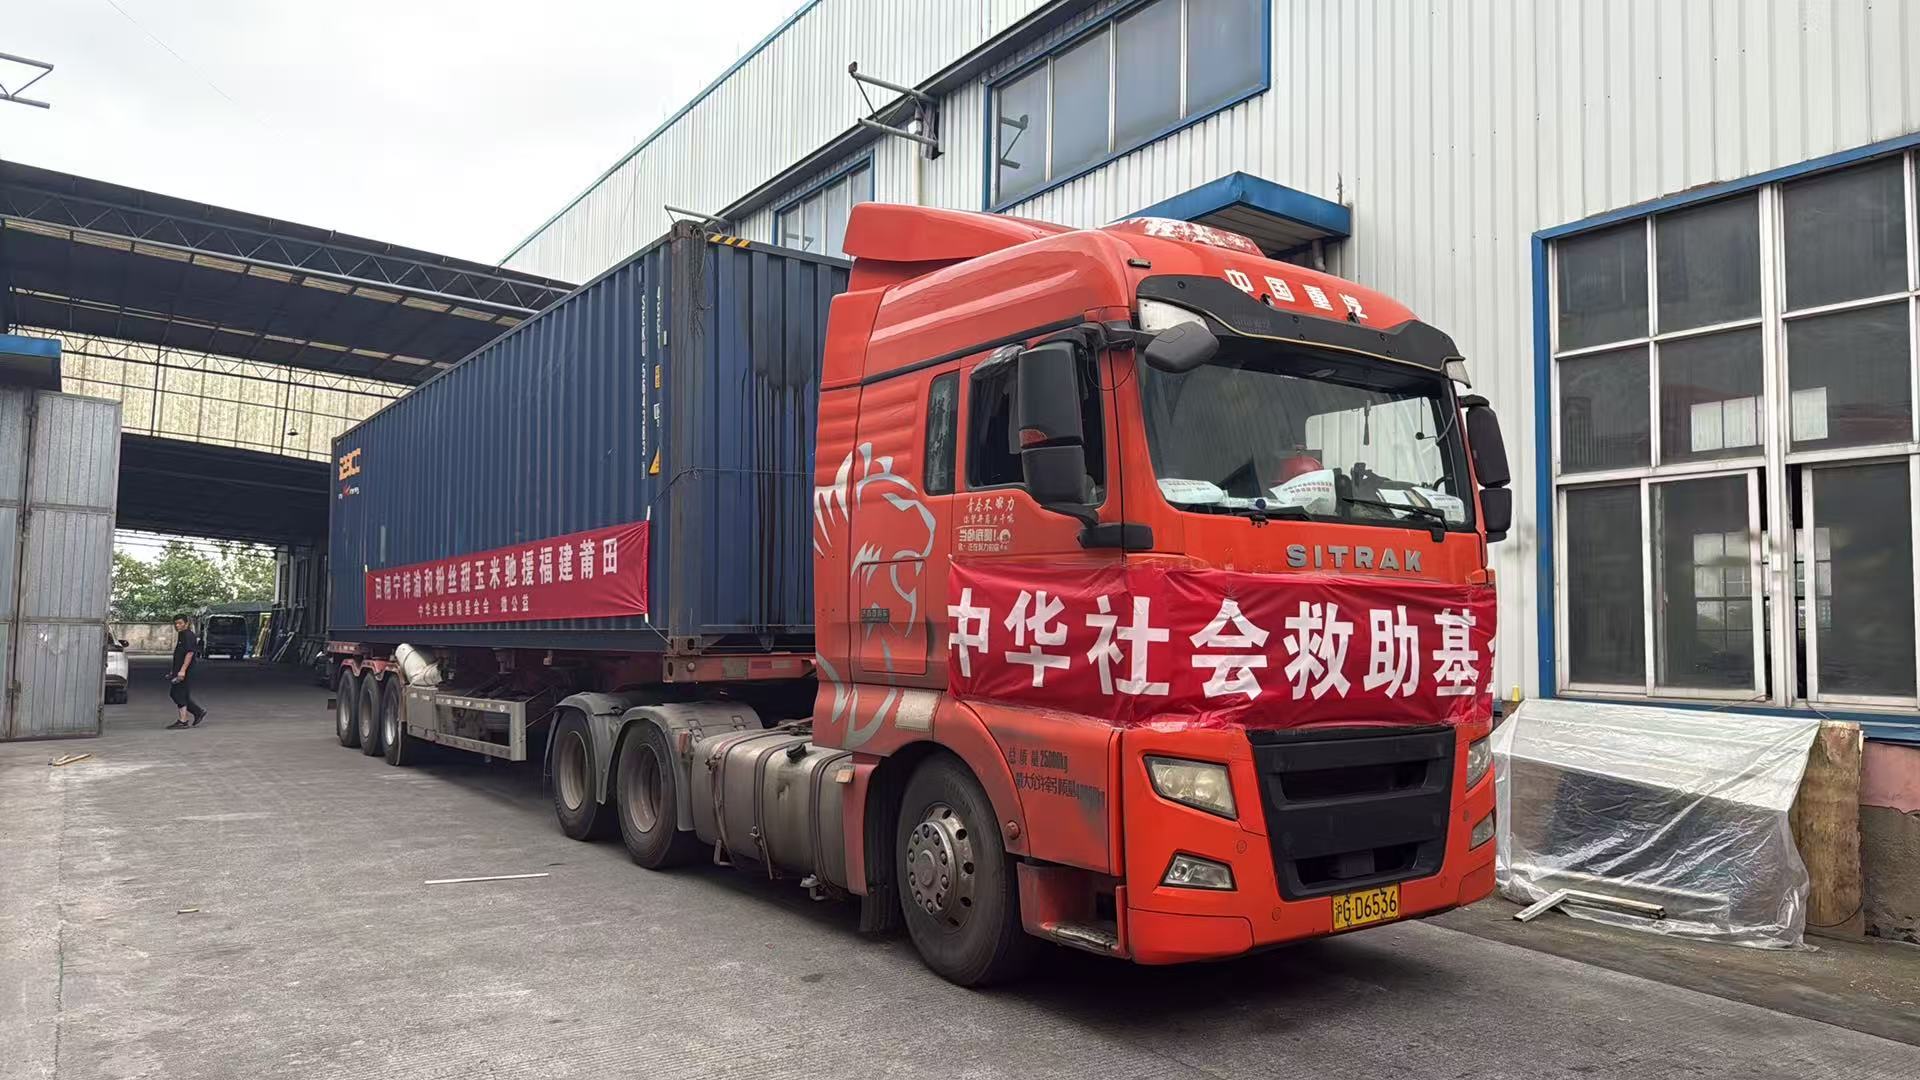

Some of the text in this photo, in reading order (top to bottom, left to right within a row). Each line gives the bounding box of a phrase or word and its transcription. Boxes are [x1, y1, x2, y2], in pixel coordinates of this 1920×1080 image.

[1286, 544, 1422, 572] SITRAK
[418, 597, 490, 618] 中华社会救助基金会
[948, 587, 1497, 700] 中华社会救助基
